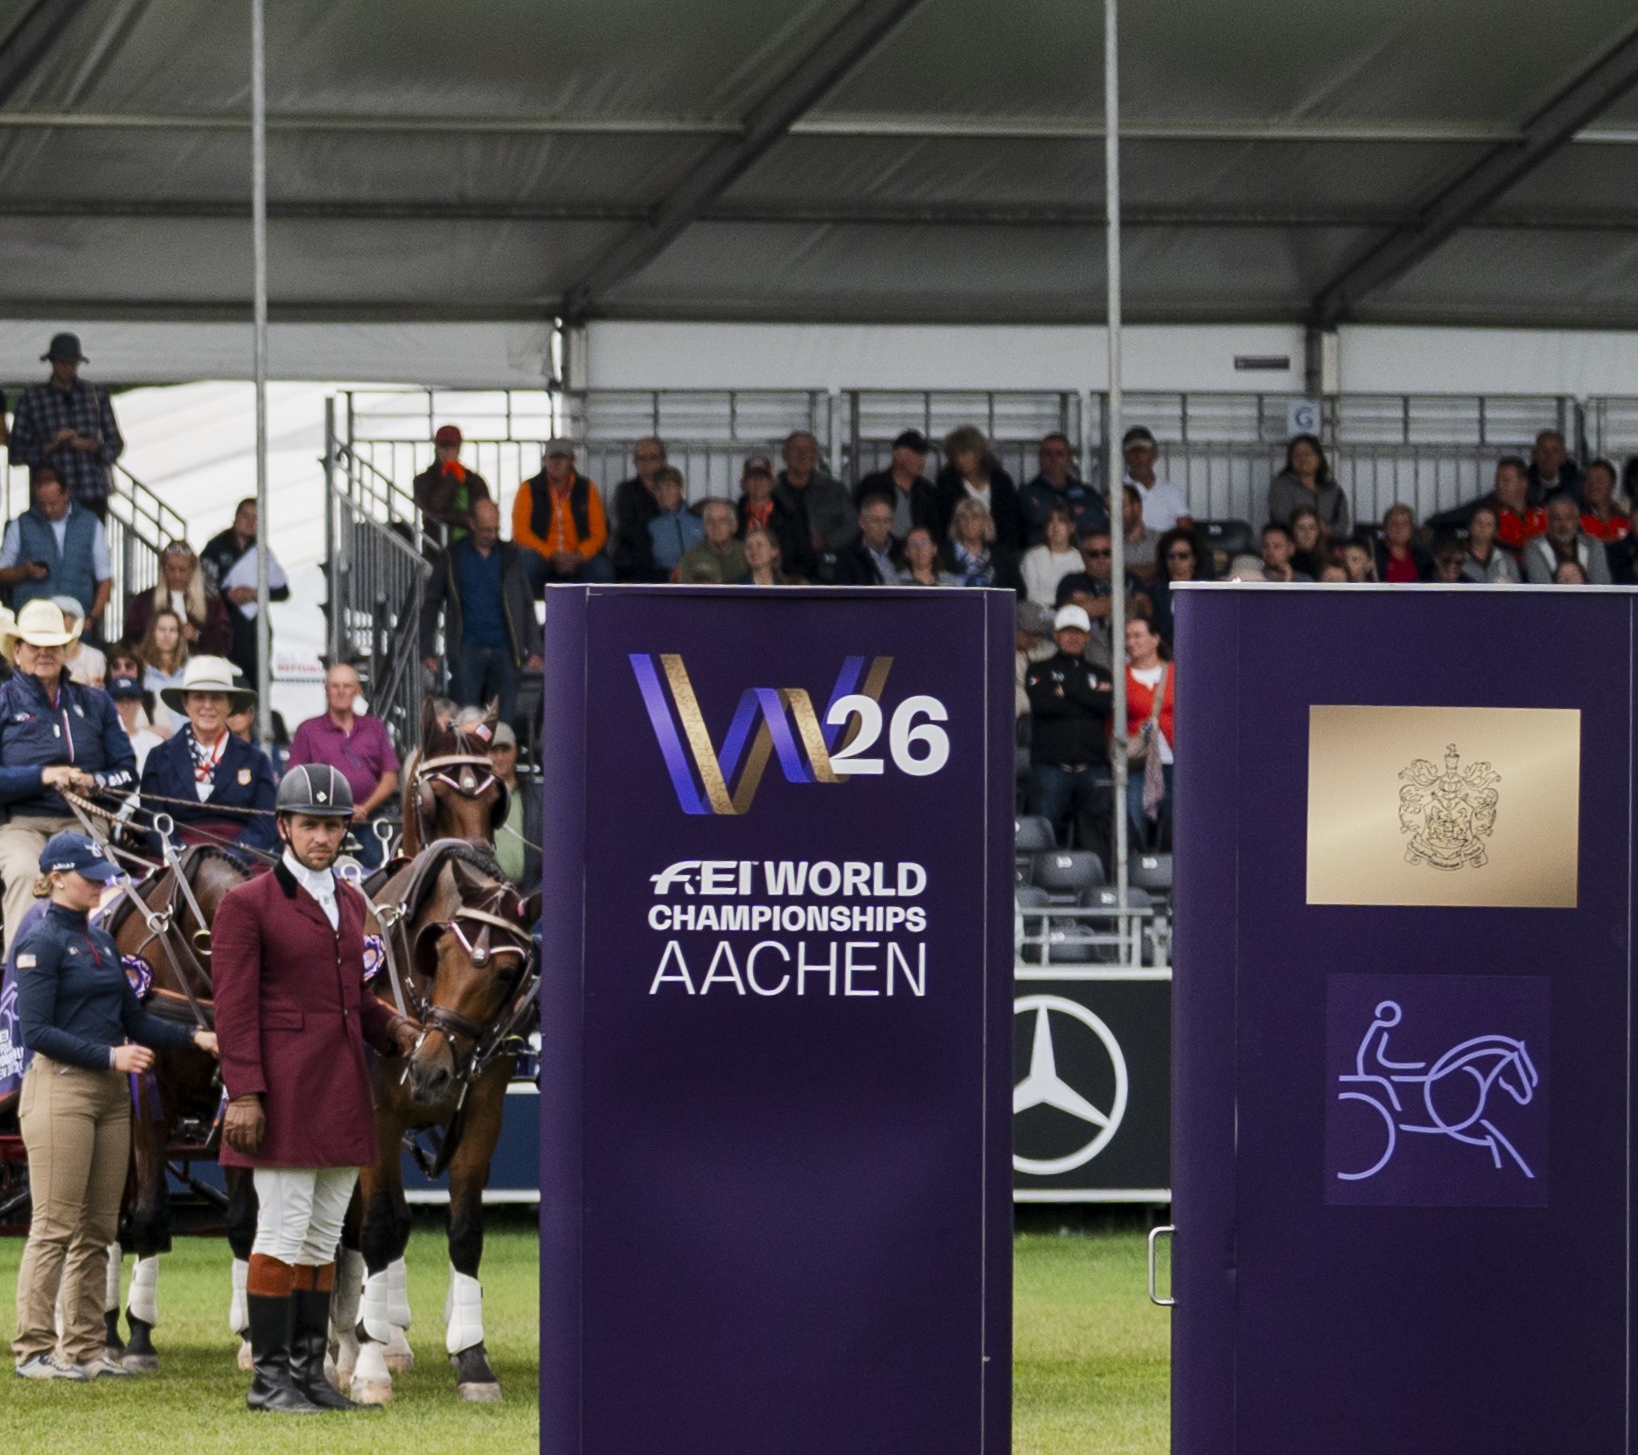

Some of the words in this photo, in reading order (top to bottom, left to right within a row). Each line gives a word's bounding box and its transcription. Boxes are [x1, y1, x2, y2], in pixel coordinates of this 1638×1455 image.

[649, 860, 754, 895] FEI
[764, 861, 928, 896] WORLD
[647, 904, 928, 933] CHAMPIONSHIPS
[648, 940, 927, 997] AACHEN
